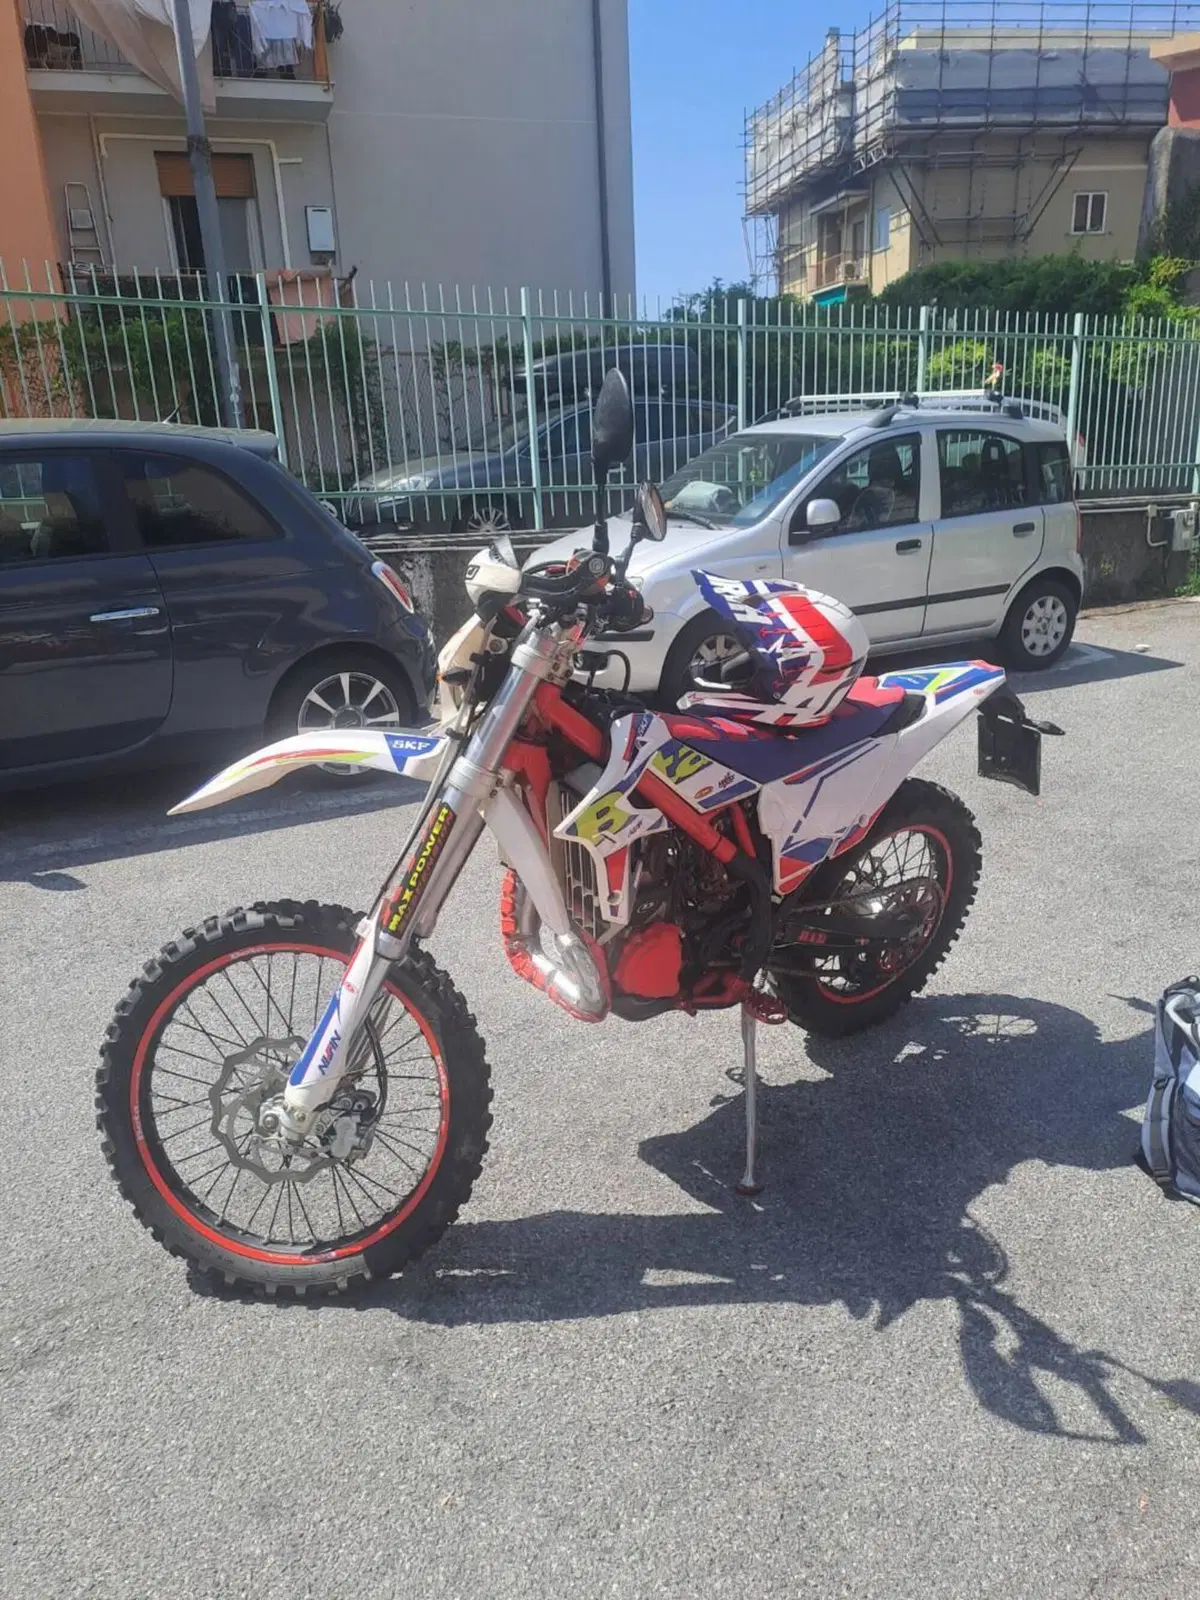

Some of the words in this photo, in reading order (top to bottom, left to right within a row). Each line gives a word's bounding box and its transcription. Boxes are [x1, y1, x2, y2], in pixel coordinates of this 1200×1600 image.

[392, 740, 430, 751] SKF
[388, 888, 414, 932] MAX
[409, 807, 449, 887] POWER
